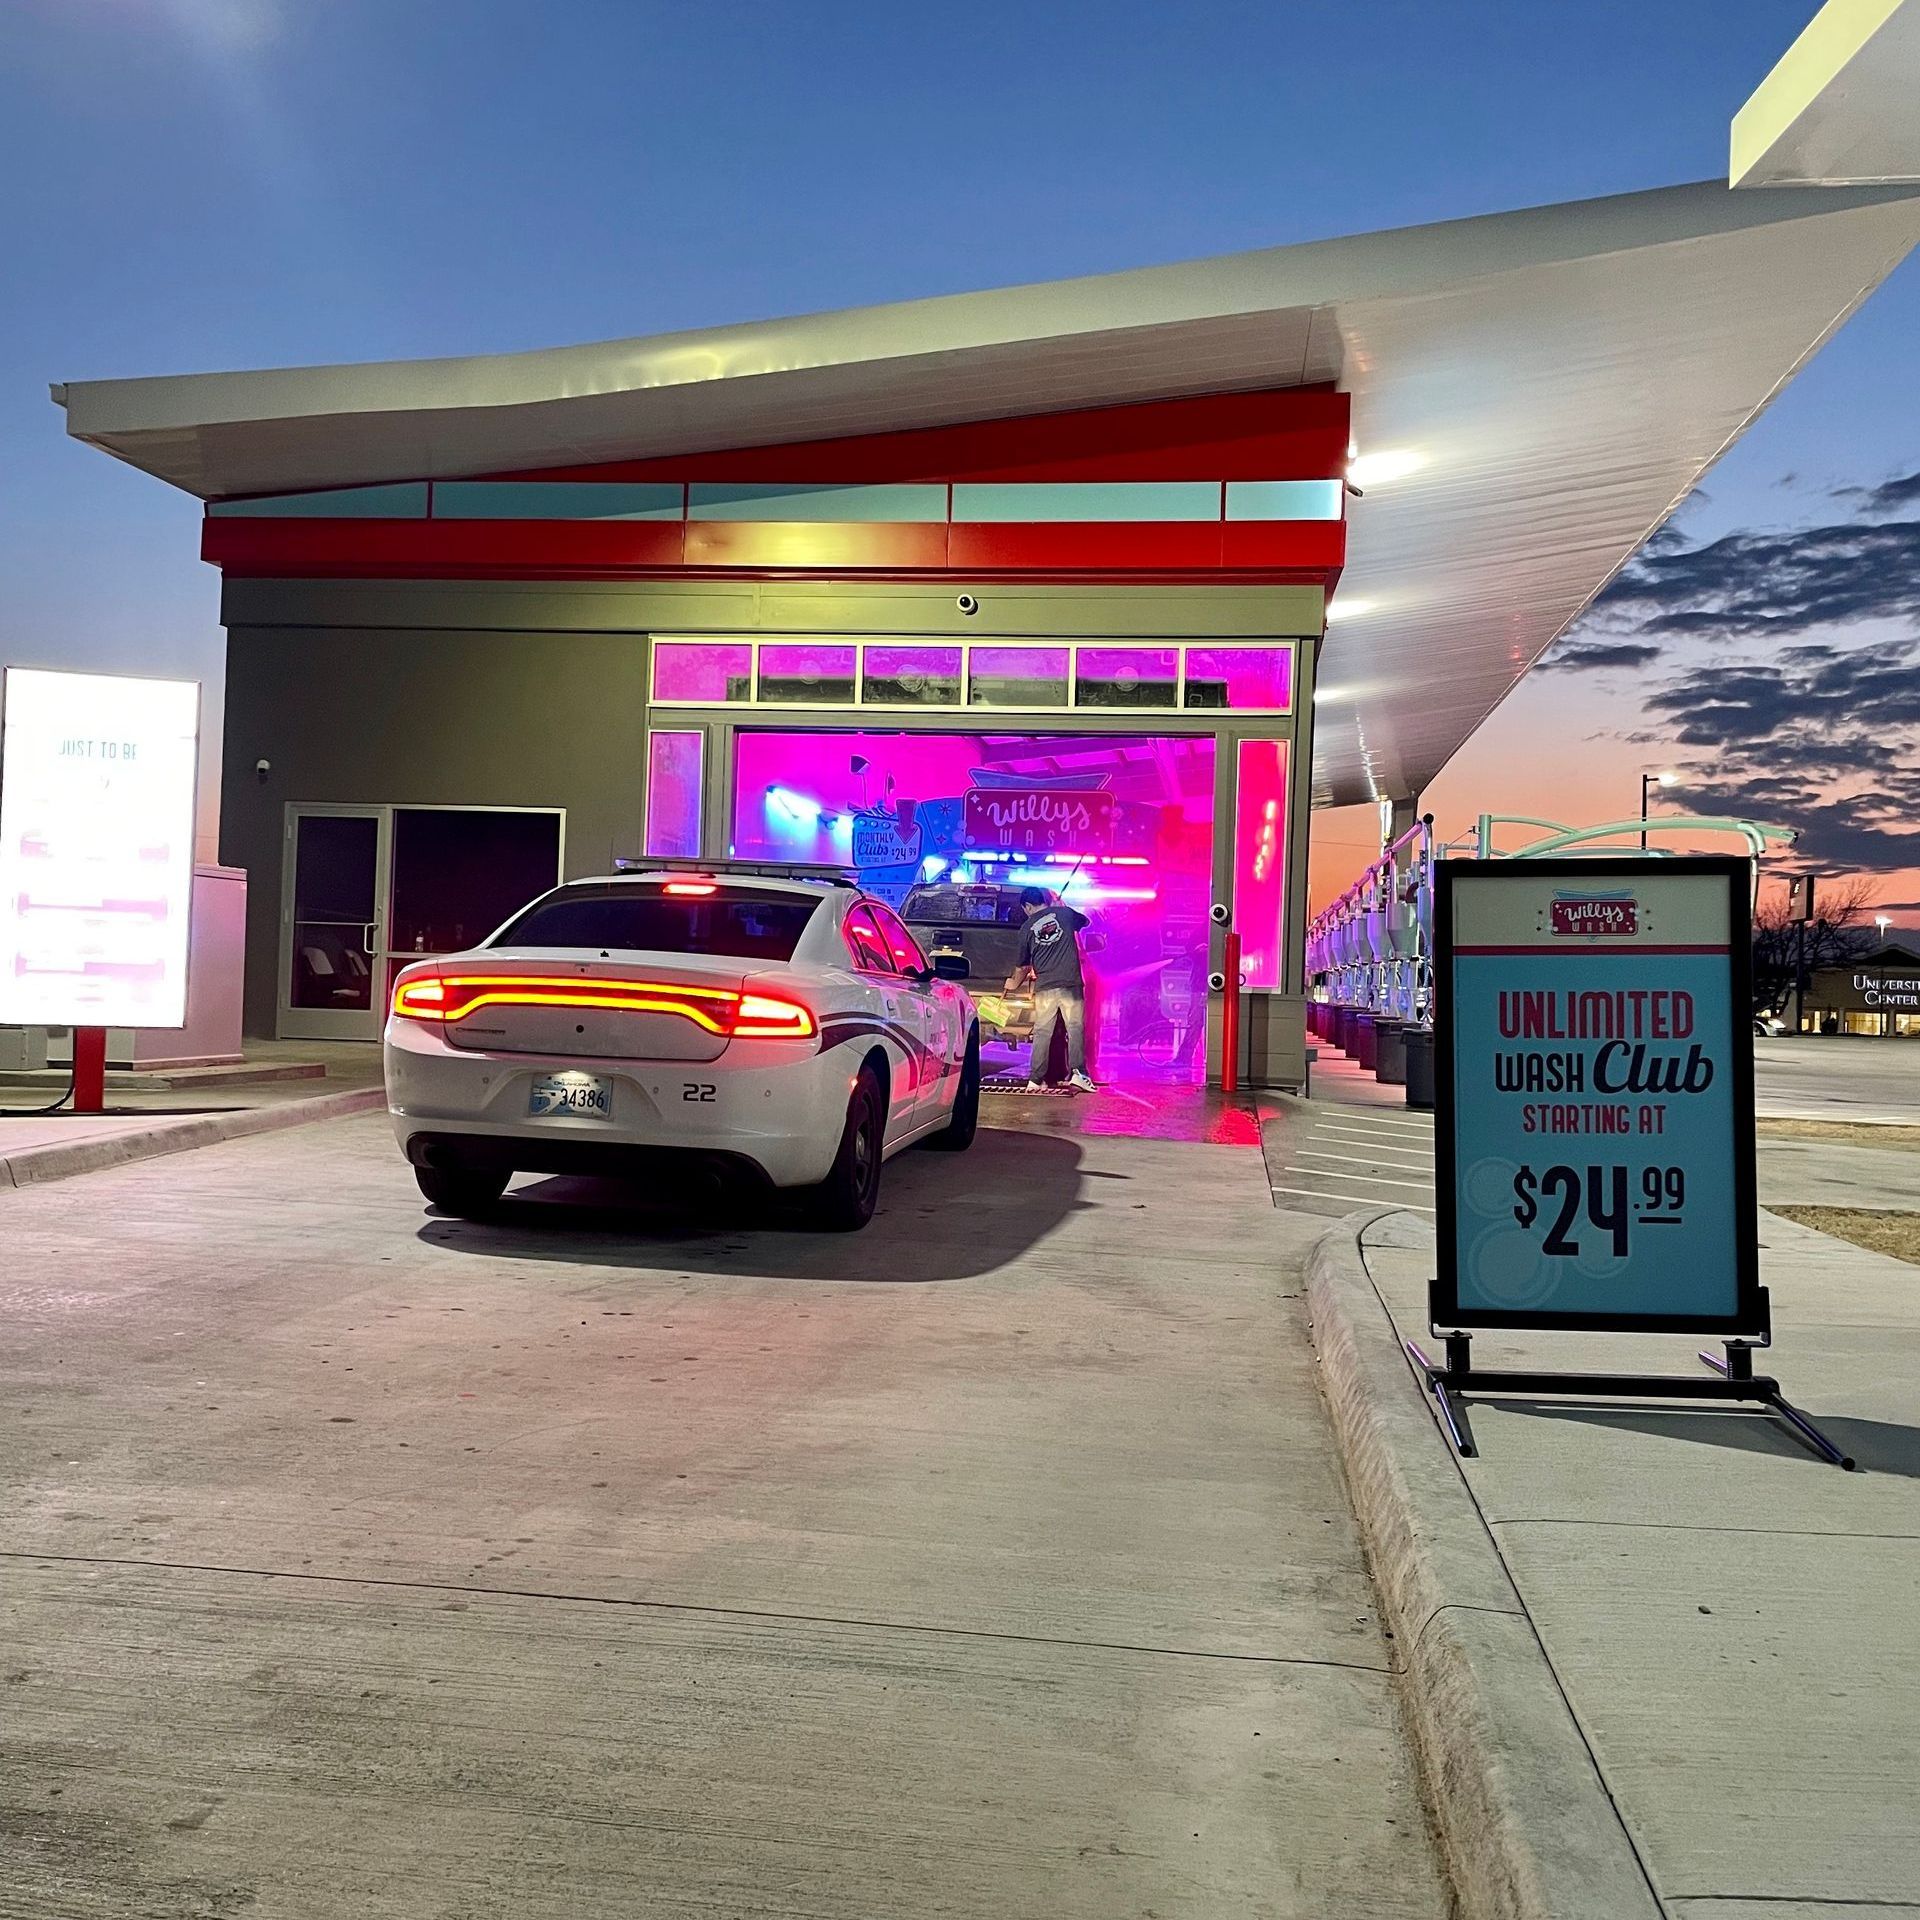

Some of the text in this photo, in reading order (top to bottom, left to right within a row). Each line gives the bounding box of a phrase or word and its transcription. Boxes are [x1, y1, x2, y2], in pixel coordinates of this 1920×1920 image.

[59, 739, 94, 758] JUST
[101, 741, 117, 759] TO
[986, 794, 1091, 832] Willys
[857, 832, 895, 845] MONTHLY
[1000, 828, 1077, 847] WASH
[857, 842, 889, 856] Clubs
[1564, 903, 1624, 924] Willys
[1572, 922, 1618, 932] WASH
[1498, 991, 1693, 1039] UNLIMITED
[1495, 1040, 1714, 1094] WASH Club
[559, 1088, 605, 1109] 34386
[683, 1083, 717, 1102] 22
[1522, 1105, 1667, 1135] STARTING AT
